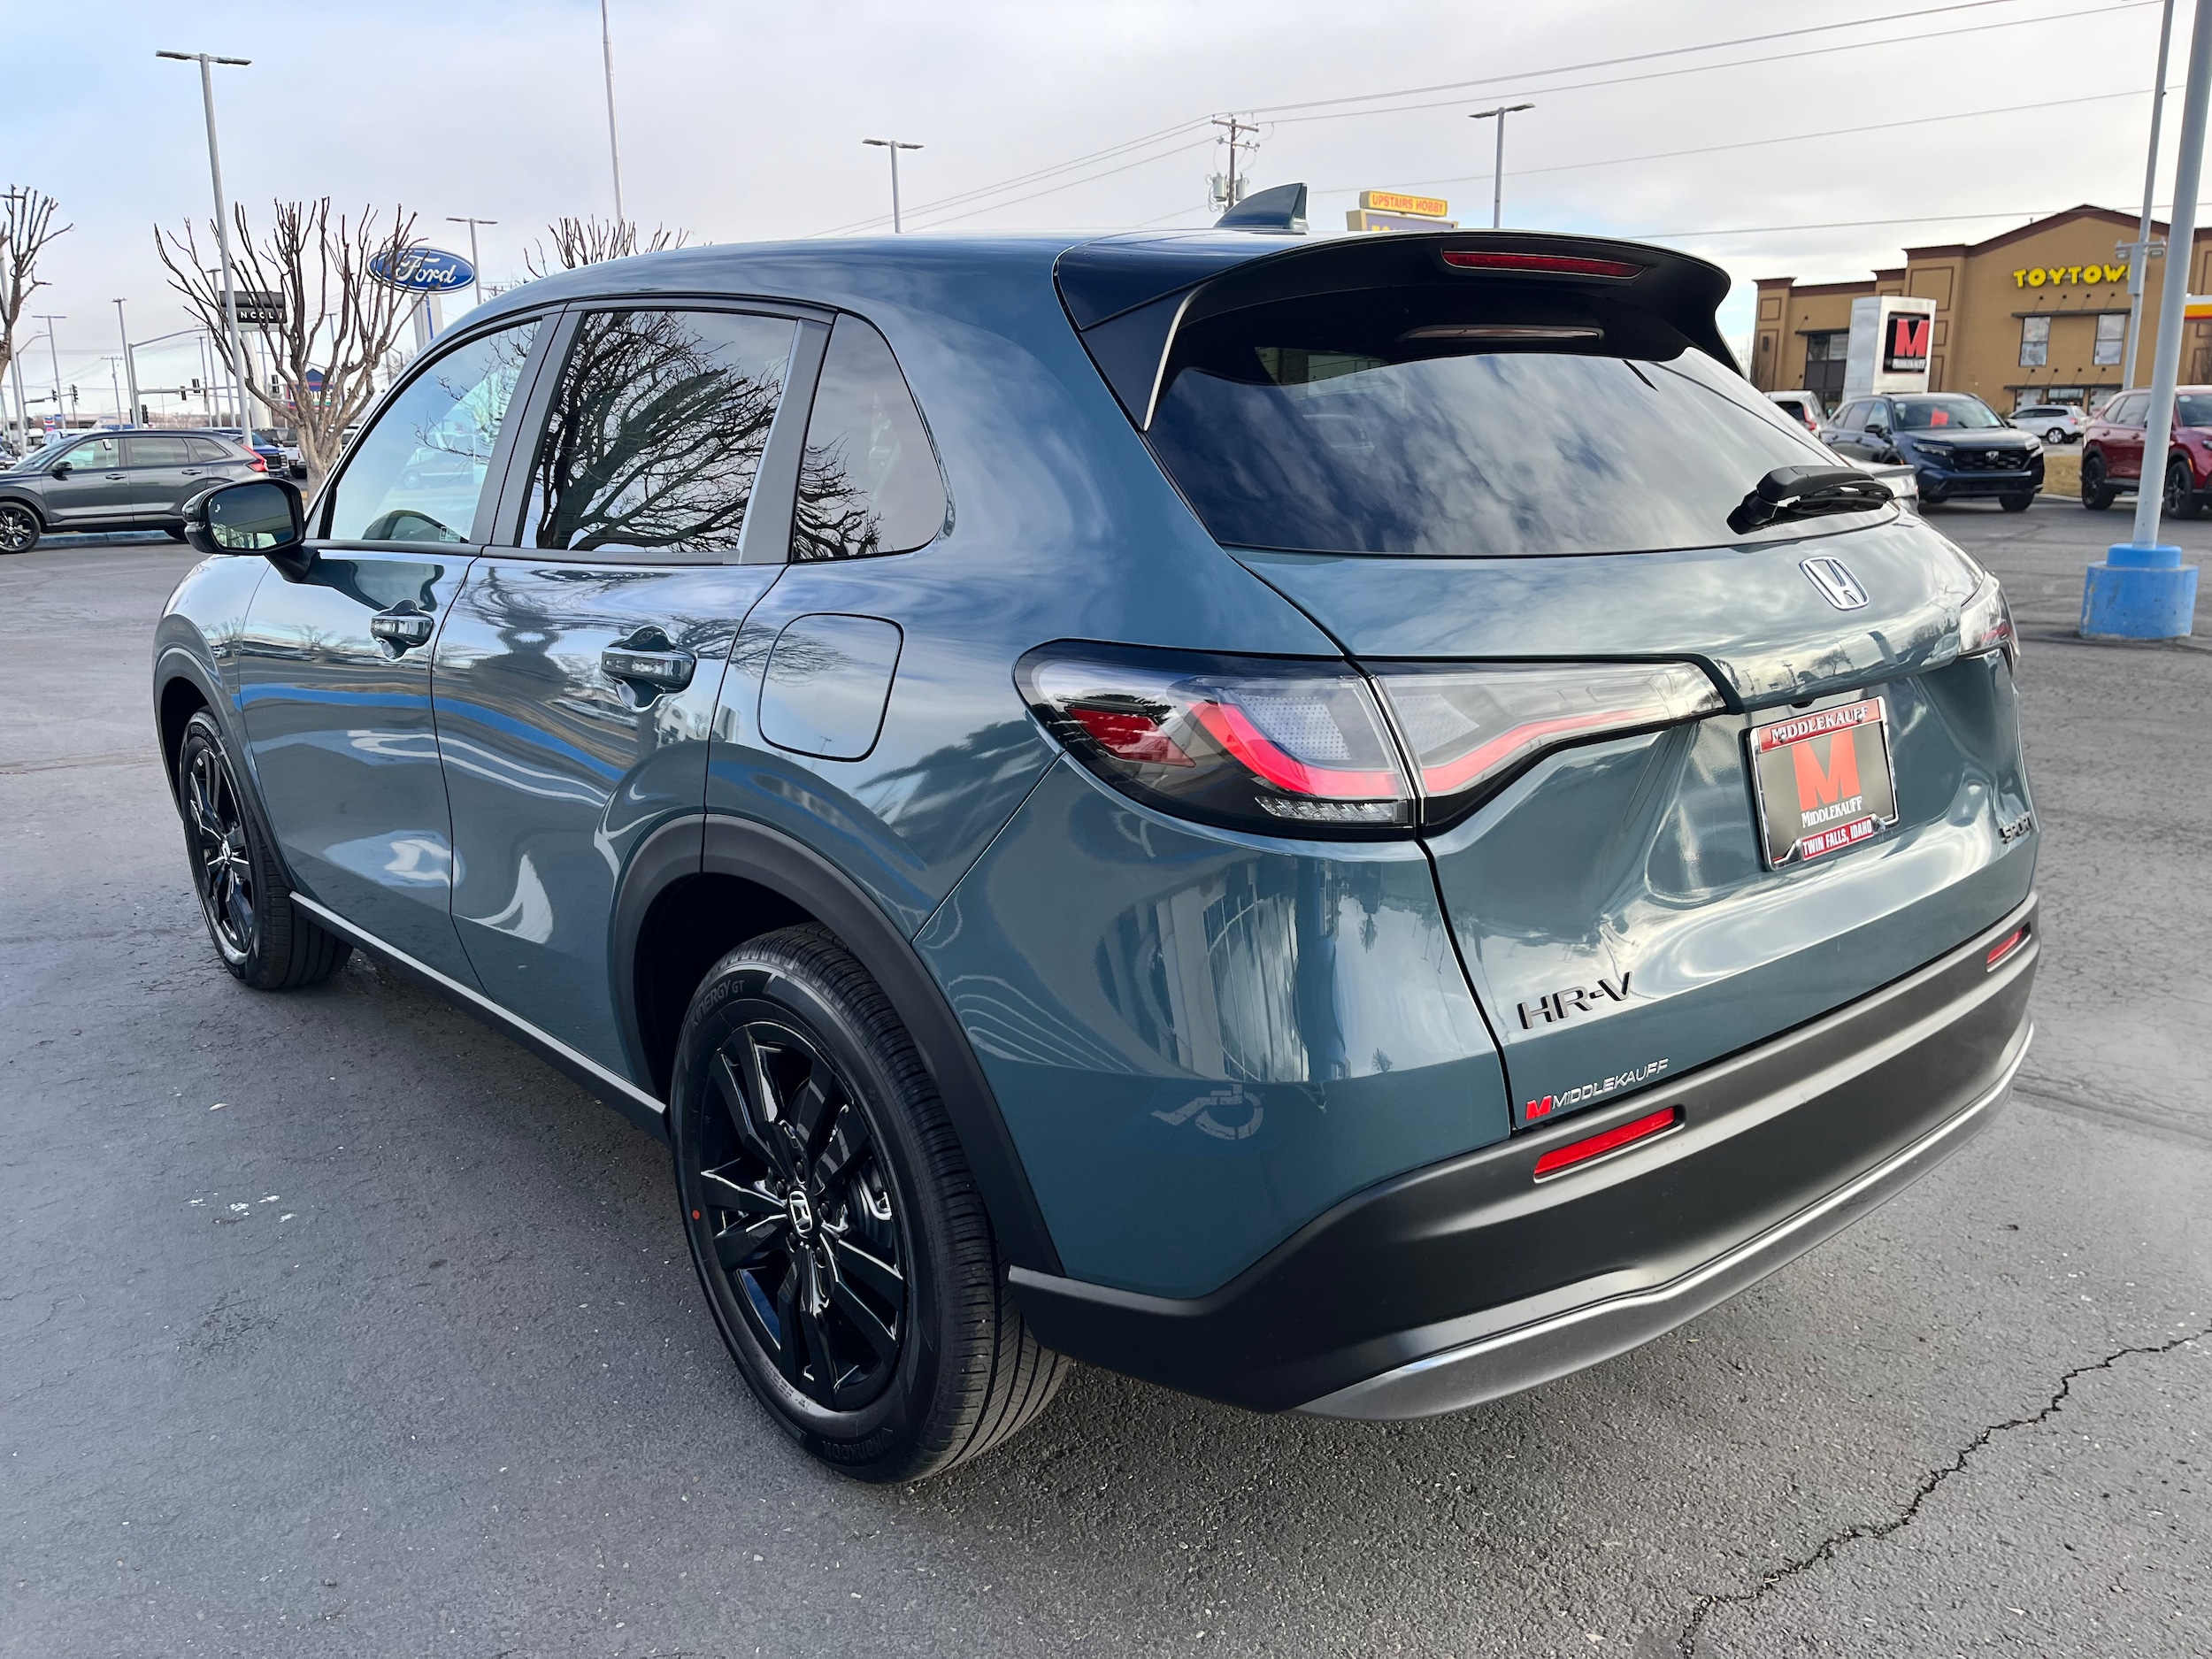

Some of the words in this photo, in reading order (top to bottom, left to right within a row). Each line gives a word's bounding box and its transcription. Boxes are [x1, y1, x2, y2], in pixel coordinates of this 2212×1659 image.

[1372, 193, 1414, 210] UPSTAIRS
[1416, 200, 1444, 213] HOBBY
[396, 254, 457, 284] Ford
[2014, 263, 2131, 288] TOYTOW
[1893, 318, 1929, 357] M
[1770, 705, 1869, 744] MIDDLEKAUFF
[1791, 728, 1862, 811] M
[1801, 795, 1863, 829] MIDDLEKAUFF
[1802, 837, 1824, 856] TWIN
[1825, 829, 1850, 850] FALLS,
[1850, 818, 1873, 839] IDAHO
[1517, 971, 1632, 1030] HR-V
[1552, 1057, 1670, 1110] MIDDLEKAUFF
